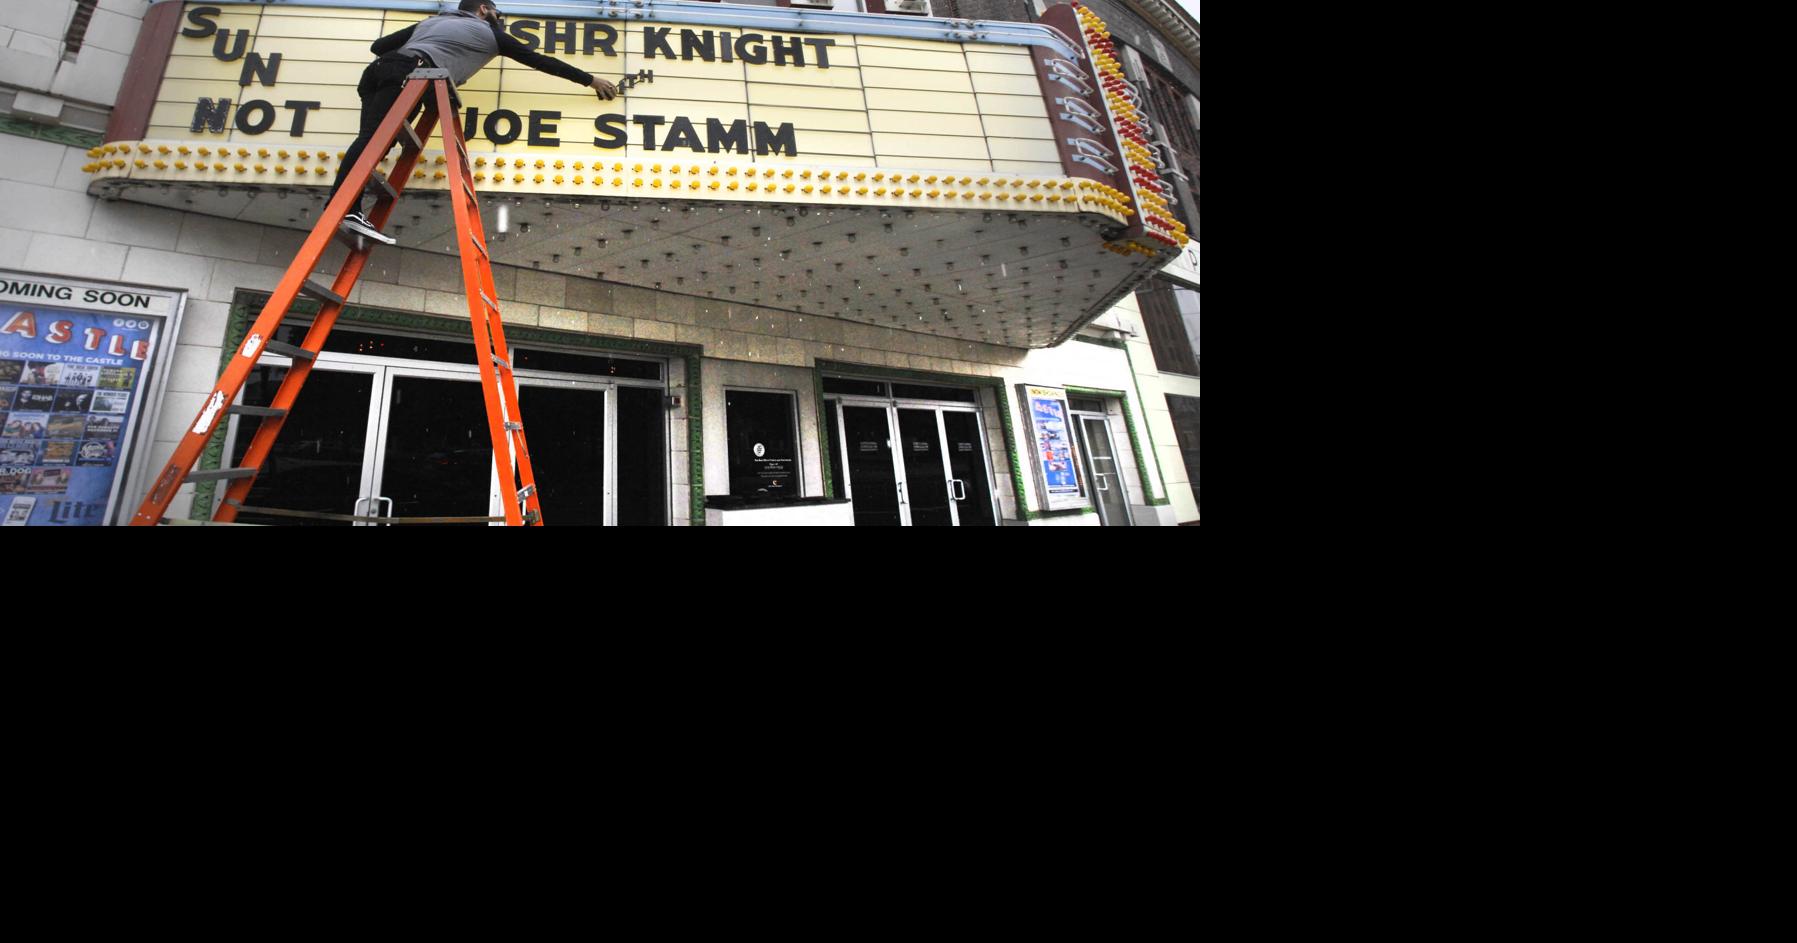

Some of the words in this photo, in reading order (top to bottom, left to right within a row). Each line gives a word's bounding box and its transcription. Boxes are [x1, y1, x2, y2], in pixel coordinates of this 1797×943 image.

[498, 18, 619, 57] SHR
[643, 25, 836, 70] KNIGHT
[189, 97, 321, 137] NOT
[464, 106, 562, 147] JOE
[593, 112, 798, 157] STAMM
[83, 289, 150, 309] SOON
[12, 351, 43, 360] SOON
[47, 353, 61, 361] TO
[63, 354, 83, 363] THE
[85, 357, 124, 366] CASTLE
